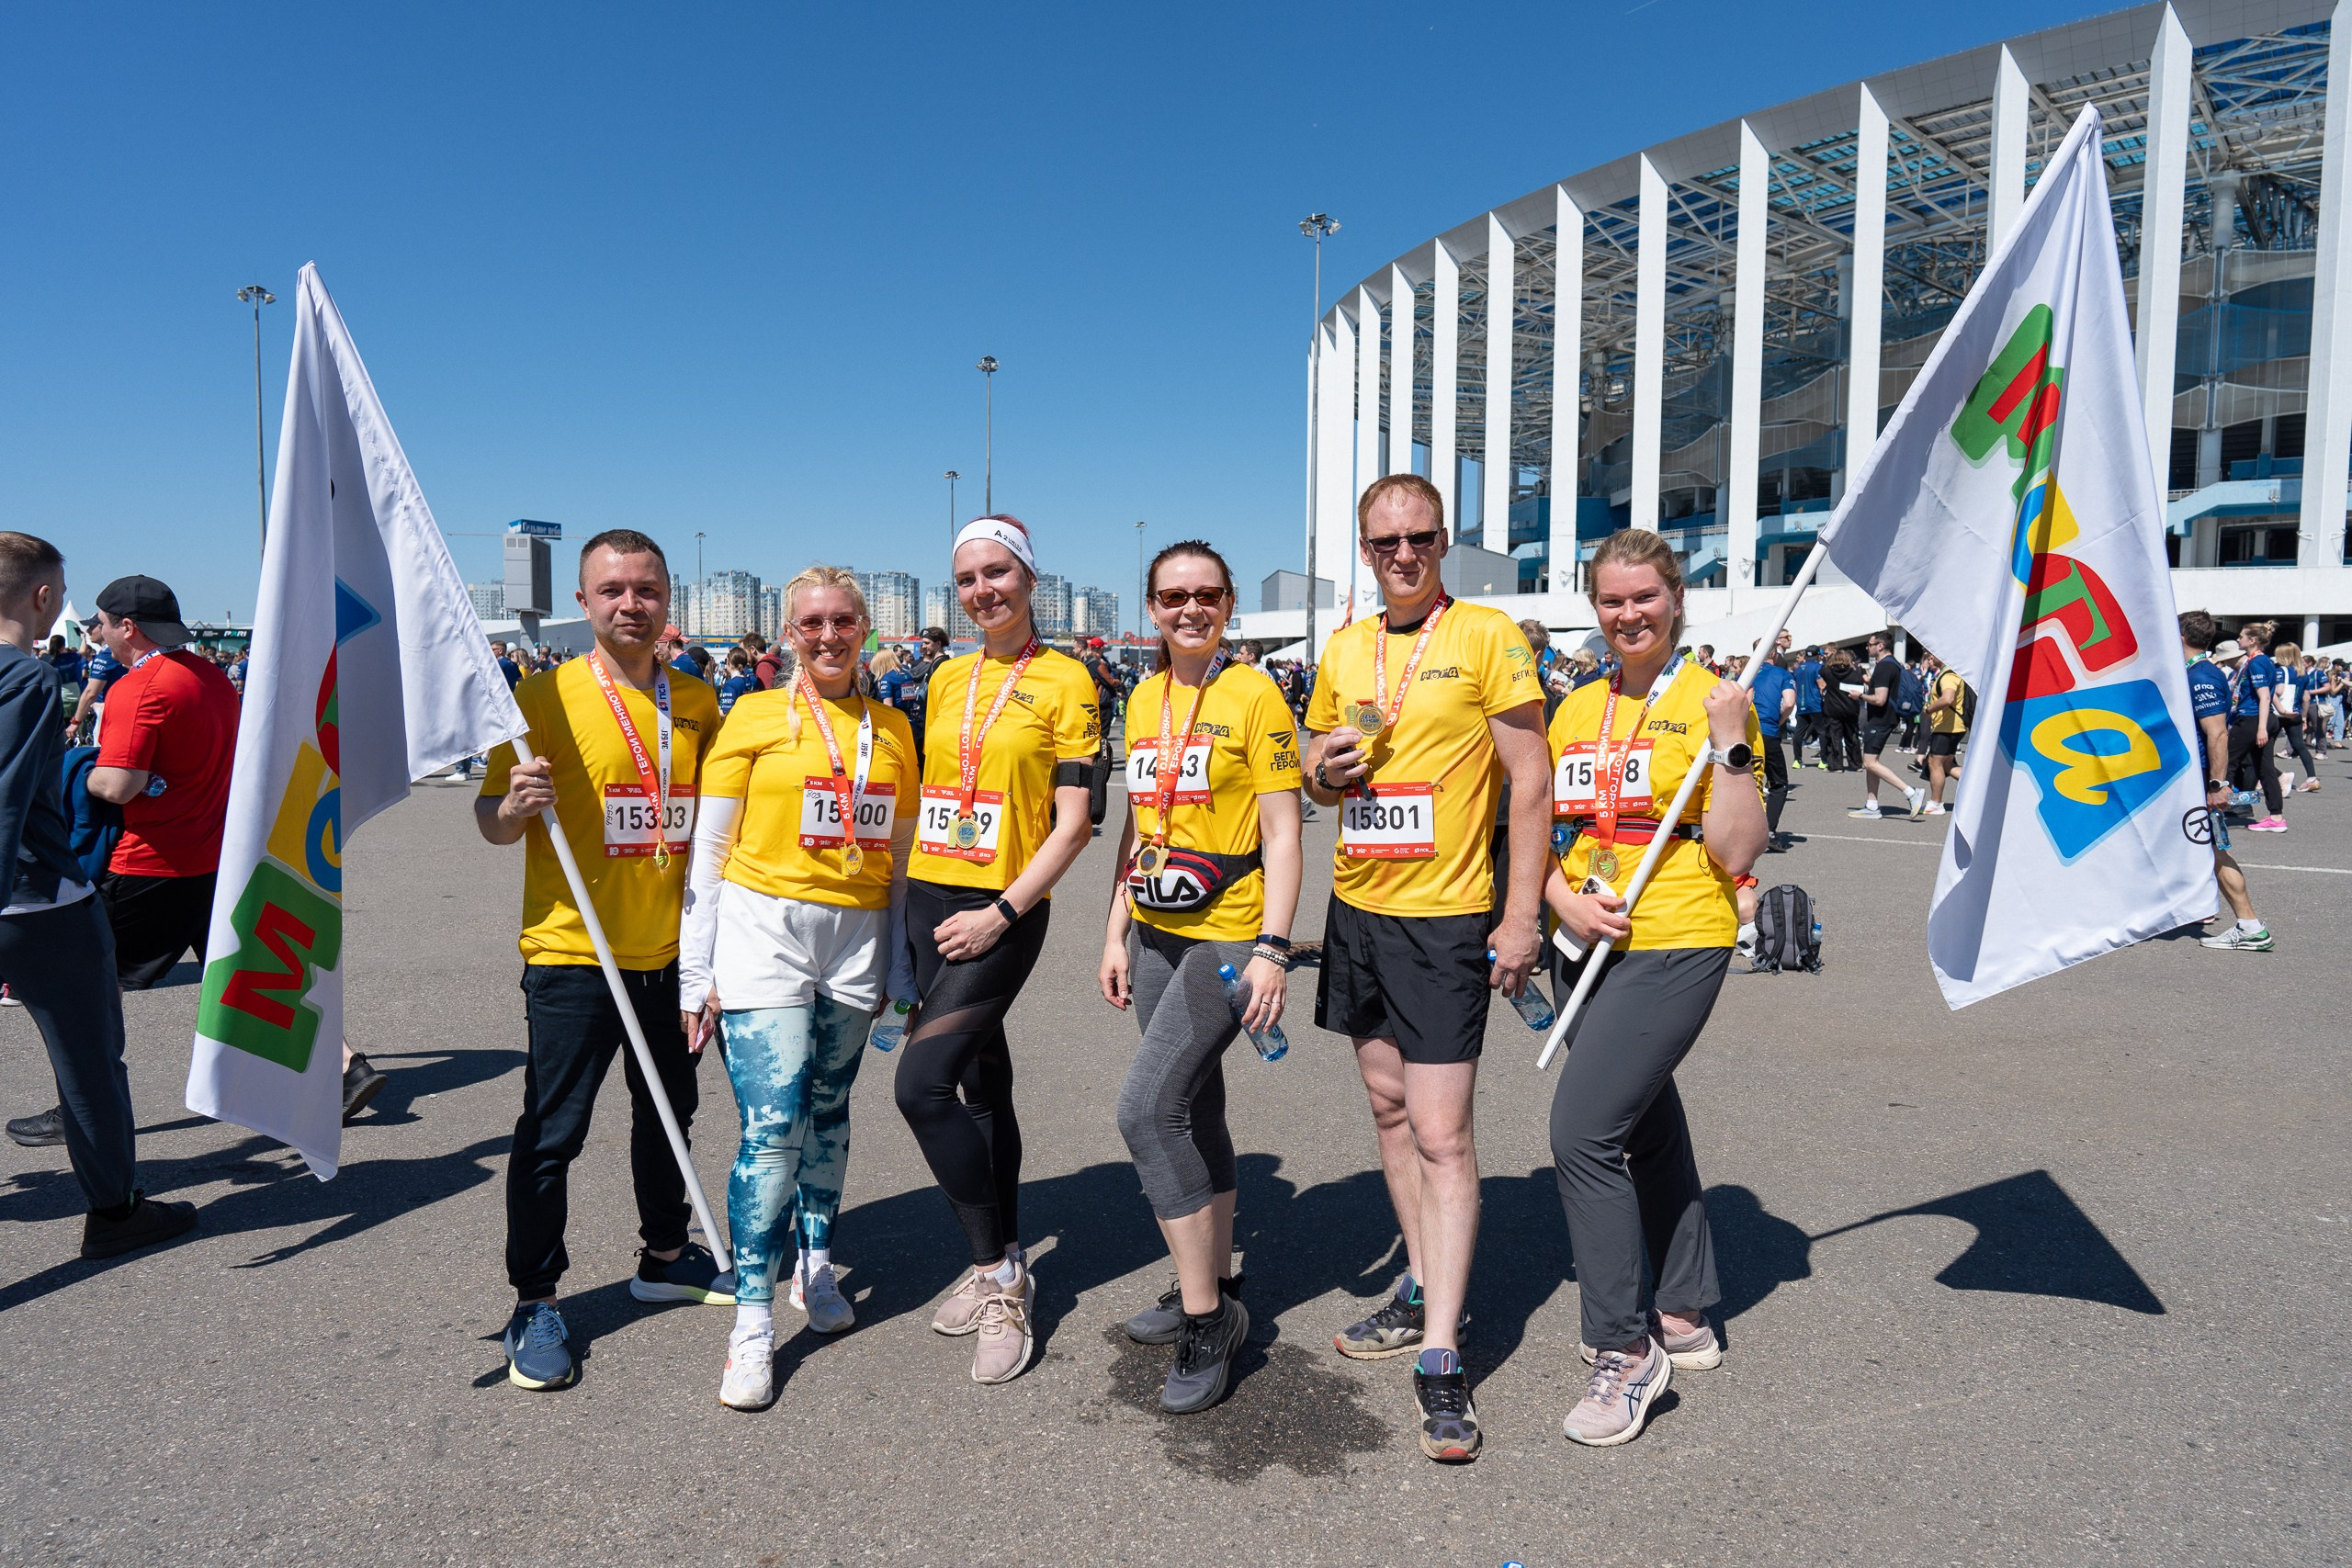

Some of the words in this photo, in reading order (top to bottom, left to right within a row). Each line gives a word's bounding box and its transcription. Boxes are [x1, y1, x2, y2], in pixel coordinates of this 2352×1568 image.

[1405, 633, 1430, 680] МЕНЯЮТ
[591, 662, 611, 687] ЭТОТ
[991, 671, 1019, 714] МЕНЯЮТ
[1015, 649, 1033, 671] ЭТОТ
[658, 682, 667, 700] ПСБ
[1376, 675, 1386, 709] ГЕРОИ
[1393, 681, 1408, 710] ЭТОТ
[1645, 690, 1659, 707] ПСБ
[605, 689, 634, 737] МЕНЯЮТ
[1160, 700, 1170, 747] МЕНЯЮТ
[1601, 692, 1617, 735] МЕНЯЮТ
[961, 722, 971, 750] ЭТОТ
[628, 737, 650, 775] ГЕРОИ
[1168, 738, 1185, 774] ГЕРОИ
[1597, 736, 1609, 771] ГЕРОИ
[1612, 744, 1629, 775] ЭТОТ
[1565, 758, 1640, 786] 158
[1598, 789, 1609, 808] КМ
[615, 806, 687, 830] 15303
[1349, 805, 1419, 830] 15301
[1128, 874, 1200, 904] FILA
